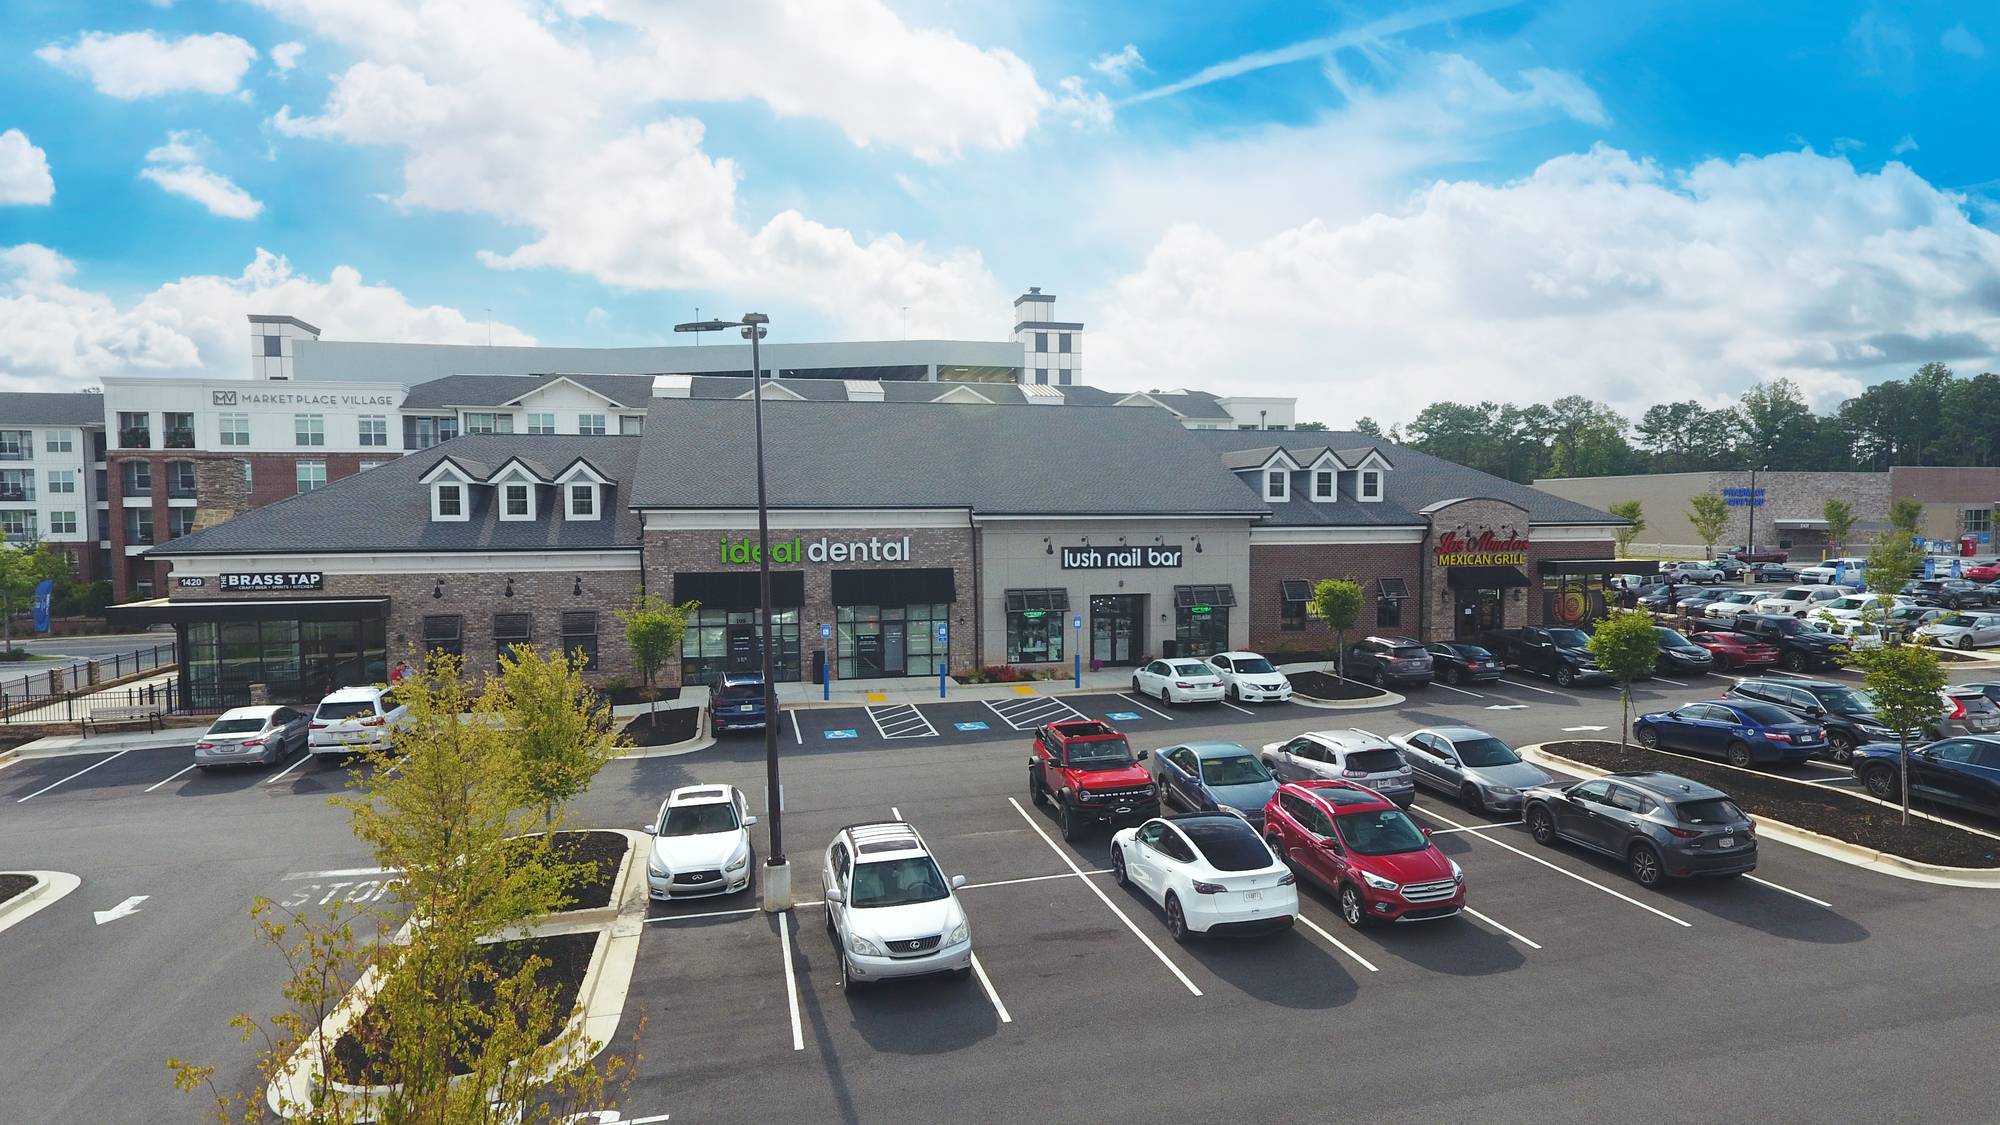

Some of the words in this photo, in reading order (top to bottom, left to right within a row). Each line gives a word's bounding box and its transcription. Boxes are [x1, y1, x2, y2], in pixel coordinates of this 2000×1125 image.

[341, 395, 393, 405] VILLAGE
[807, 536, 910, 561] dental
[1064, 548, 1101, 567] lush
[1106, 548, 1141, 566] nail
[1148, 548, 1181, 566] bar
[1439, 553, 1491, 566] MEXICAN
[1494, 554, 1525, 565] GRILL
[181, 578, 202, 587] 1420
[220, 575, 228, 589] THE
[228, 575, 284, 586] BRASS
[288, 574, 320, 585] TAP
